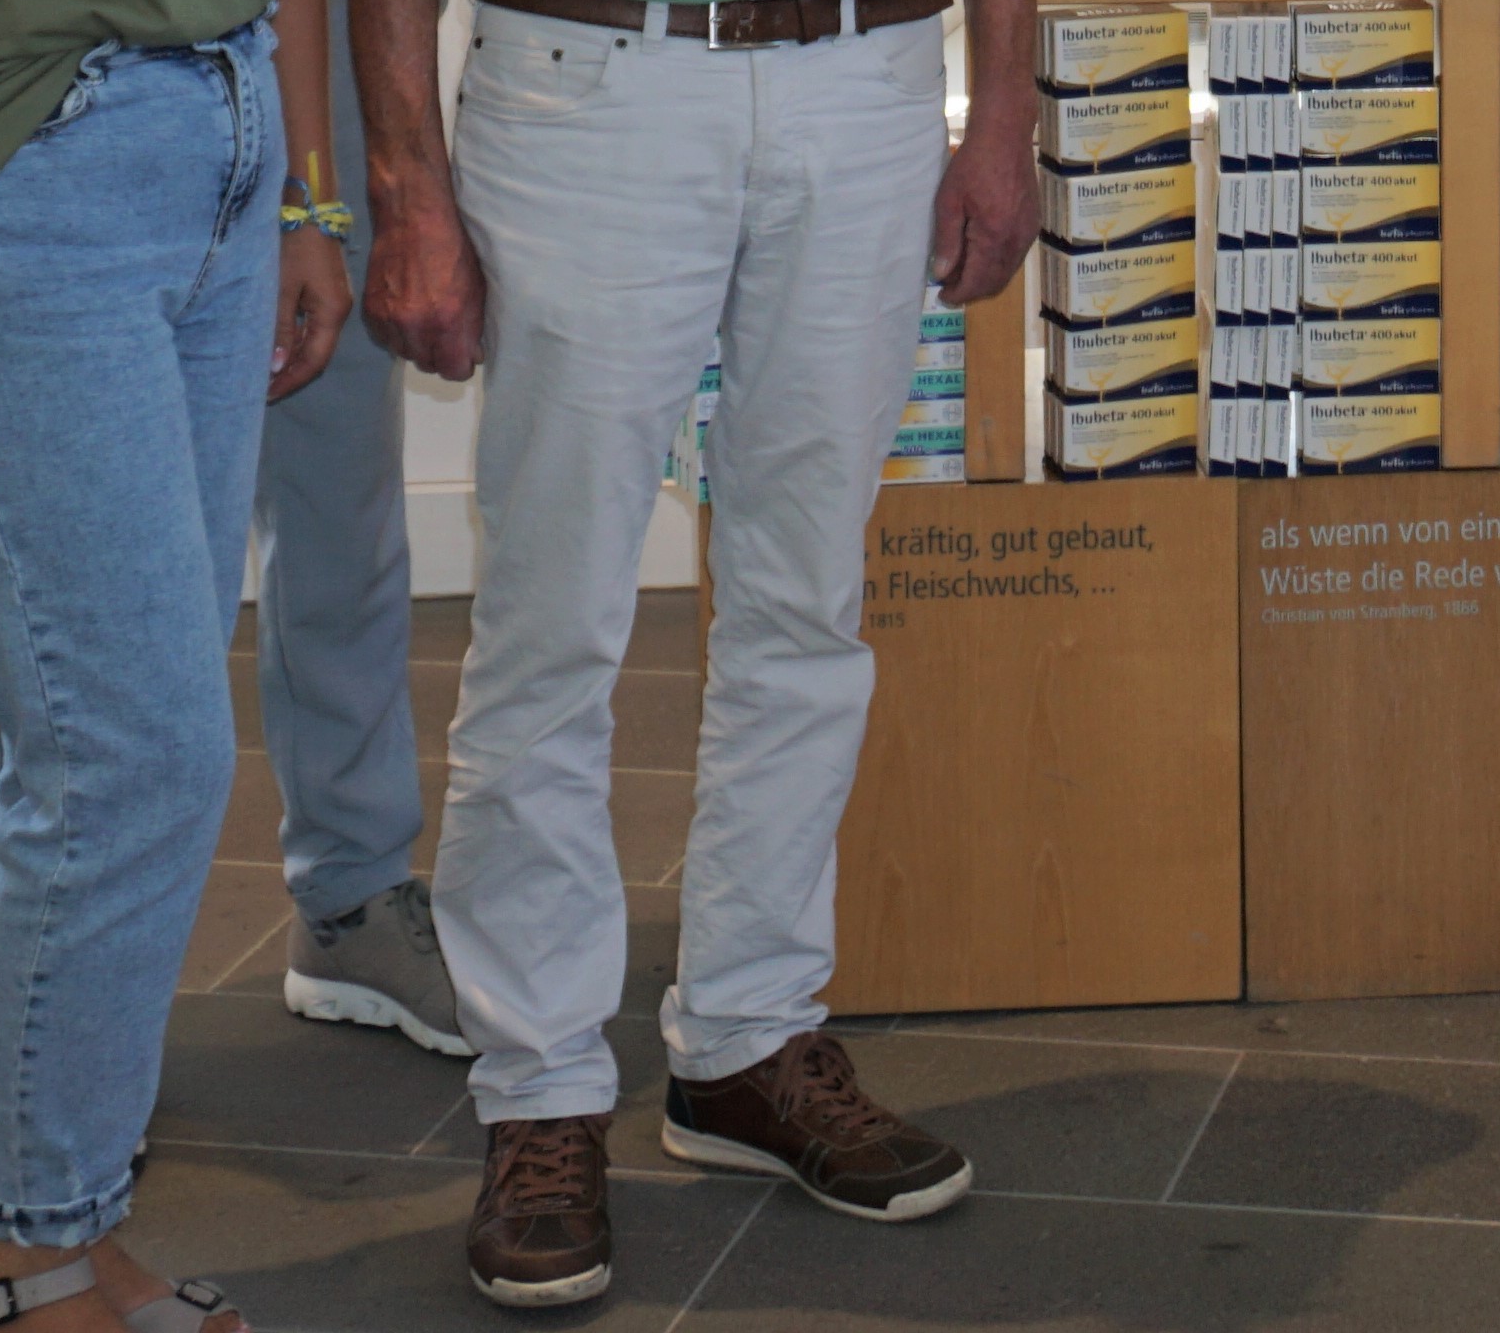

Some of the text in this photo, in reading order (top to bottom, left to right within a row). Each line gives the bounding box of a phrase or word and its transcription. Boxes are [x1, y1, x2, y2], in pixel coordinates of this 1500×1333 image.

[1122, 27, 1142, 36] 400
[1304, 20, 1411, 35] Ibubeta 400 akut
[1371, 253, 1393, 263] 400
[881, 521, 1155, 562] kräftig, gut gebaut,
[1261, 519, 1299, 550] als
[1310, 521, 1388, 547] wenn
[1398, 521, 1450, 544] von
[888, 568, 1080, 600] Fleischwuchs,
[1261, 563, 1351, 596] Wüste
[1362, 562, 1404, 591] die
[1416, 559, 1485, 589] Rede
[1262, 605, 1324, 625] Christian
[1331, 607, 1355, 621] von
